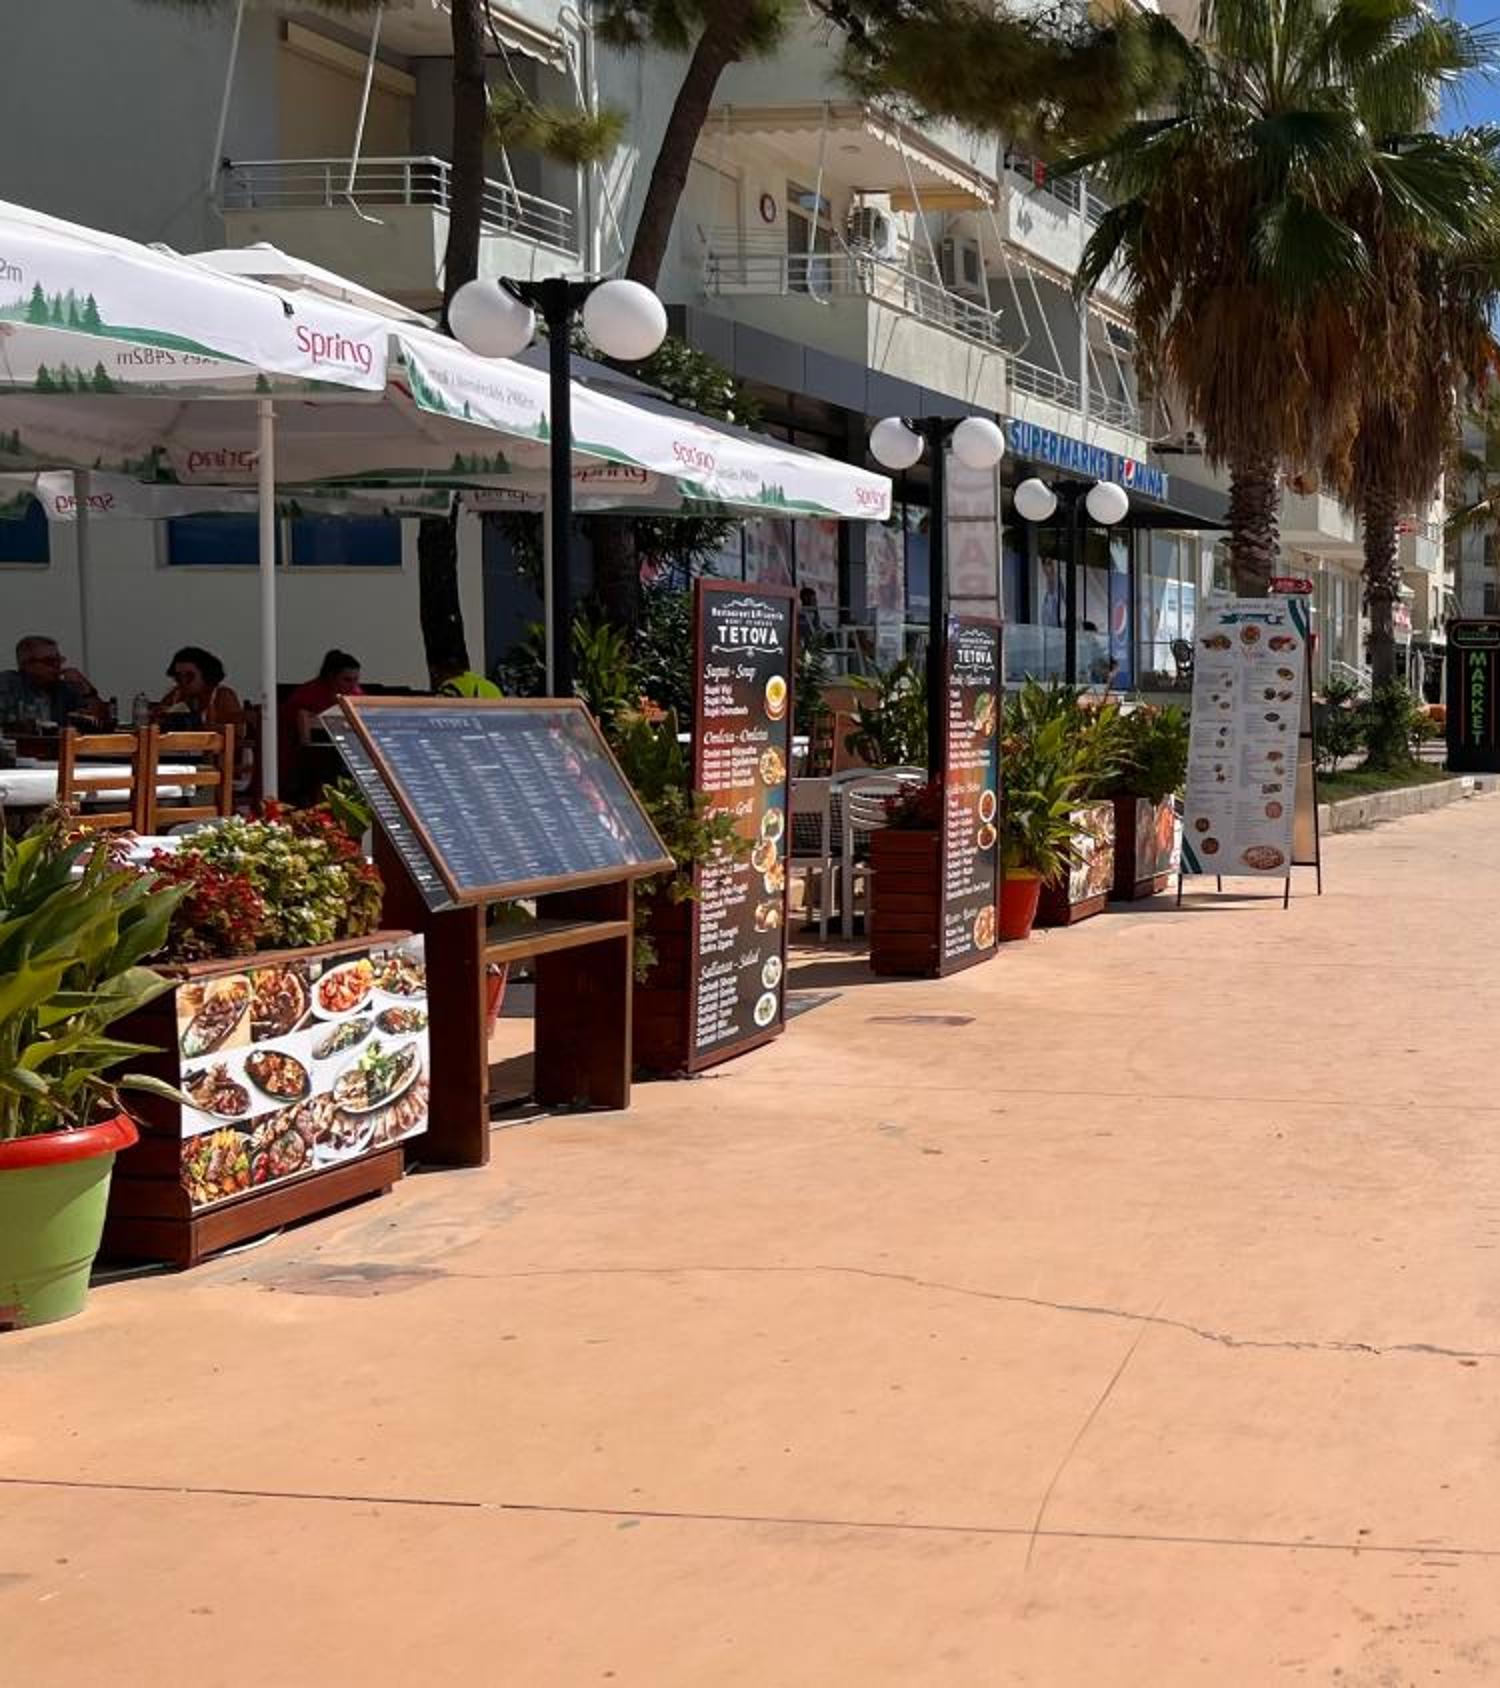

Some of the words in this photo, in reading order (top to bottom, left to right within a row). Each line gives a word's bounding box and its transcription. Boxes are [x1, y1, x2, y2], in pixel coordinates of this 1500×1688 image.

[297, 325, 372, 373] Spring
[1010, 420, 1113, 480] SUPERMARKET
[717, 625, 778, 645] TETOVA
[1469, 651, 1488, 746] MARKET
